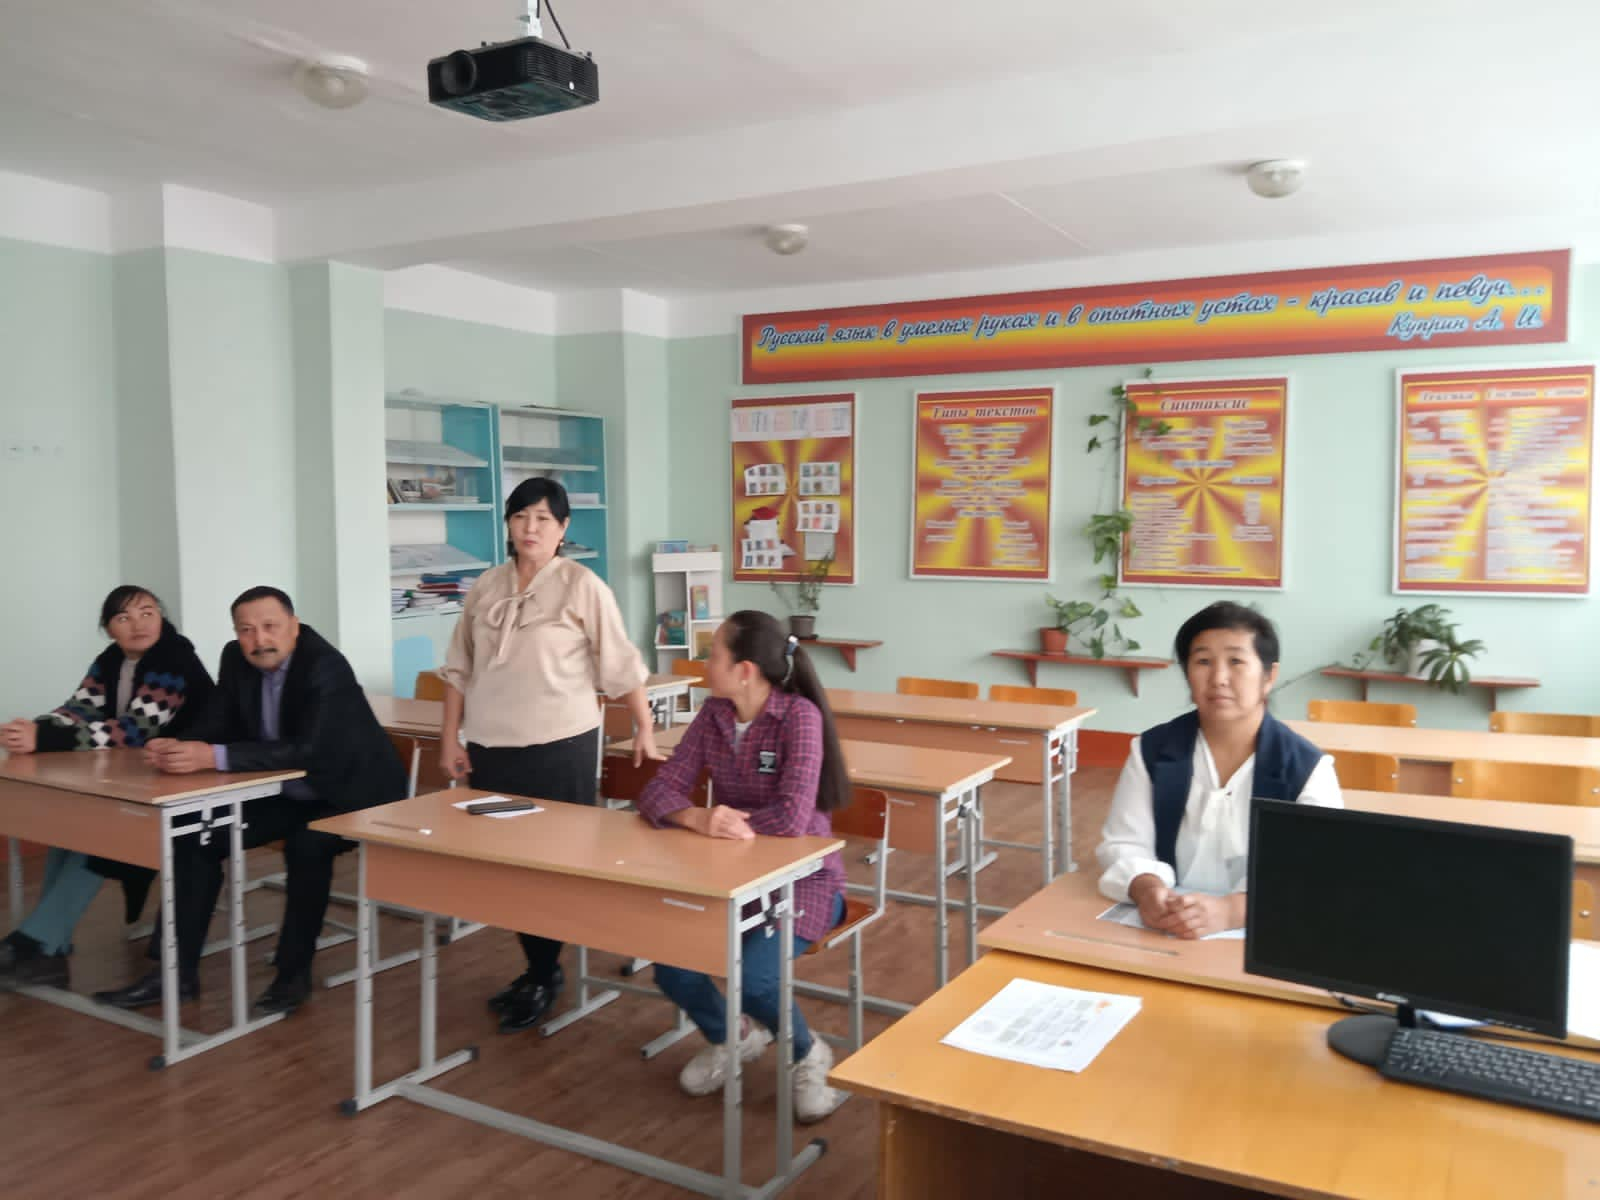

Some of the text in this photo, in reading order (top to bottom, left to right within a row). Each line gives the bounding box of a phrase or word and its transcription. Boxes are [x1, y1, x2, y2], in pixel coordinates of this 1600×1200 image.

[758, 320, 829, 352] Русский
[833, 326, 877, 342] язык
[881, 319, 898, 339] в
[898, 318, 972, 343] умелых
[974, 314, 1039, 339] руках
[1044, 313, 1060, 328] и
[1066, 304, 1083, 326] в
[1088, 299, 1195, 323] опытных
[1198, 293, 1277, 323] устах
[1308, 280, 1402, 315] красив
[1408, 285, 1427, 302] и
[1388, 311, 1468, 340] Куприн
[975, 405, 1037, 417] текстов
[1160, 398, 1248, 411] Синтаксис
